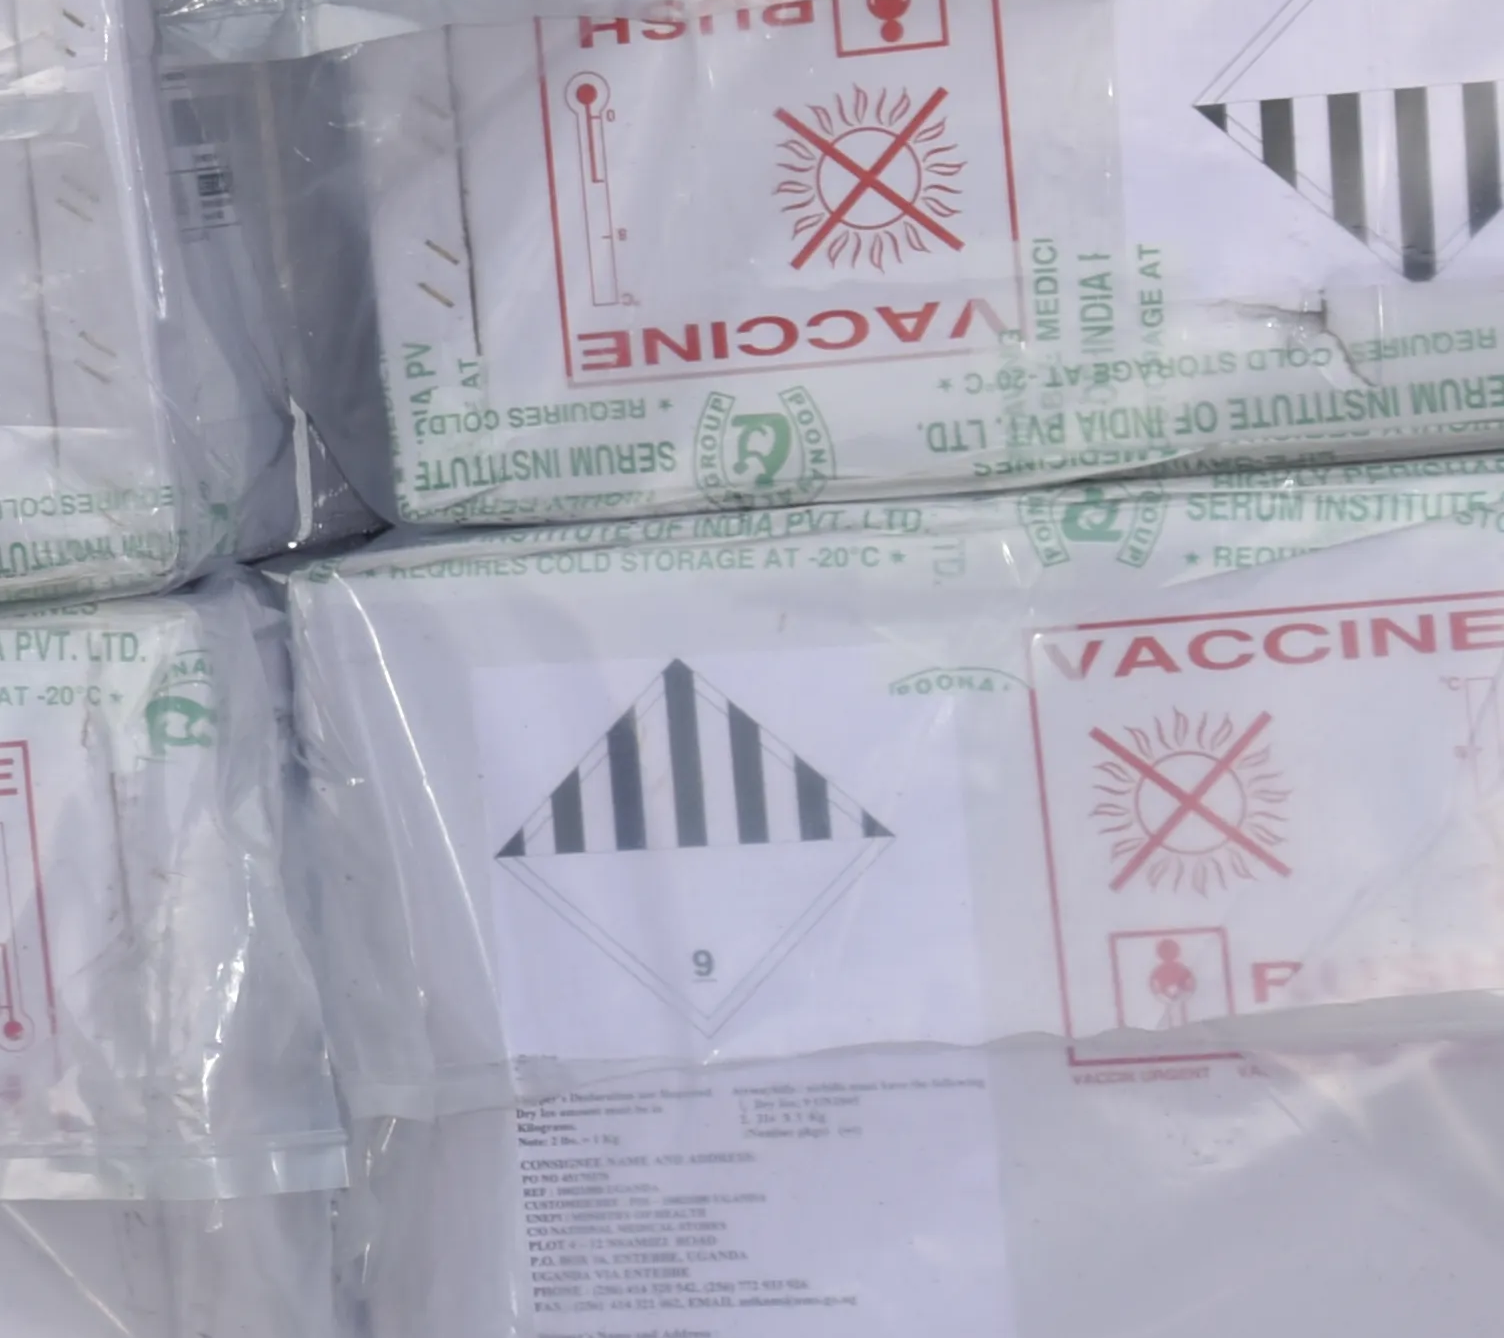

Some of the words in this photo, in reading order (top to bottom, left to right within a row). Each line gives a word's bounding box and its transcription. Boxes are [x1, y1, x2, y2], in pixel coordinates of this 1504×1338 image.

[576, 296, 1019, 373] VACCINE
[17, 631, 78, 663] PVT.
[37, 685, 101, 707] -20°C
[691, 948, 716, 979] 9
